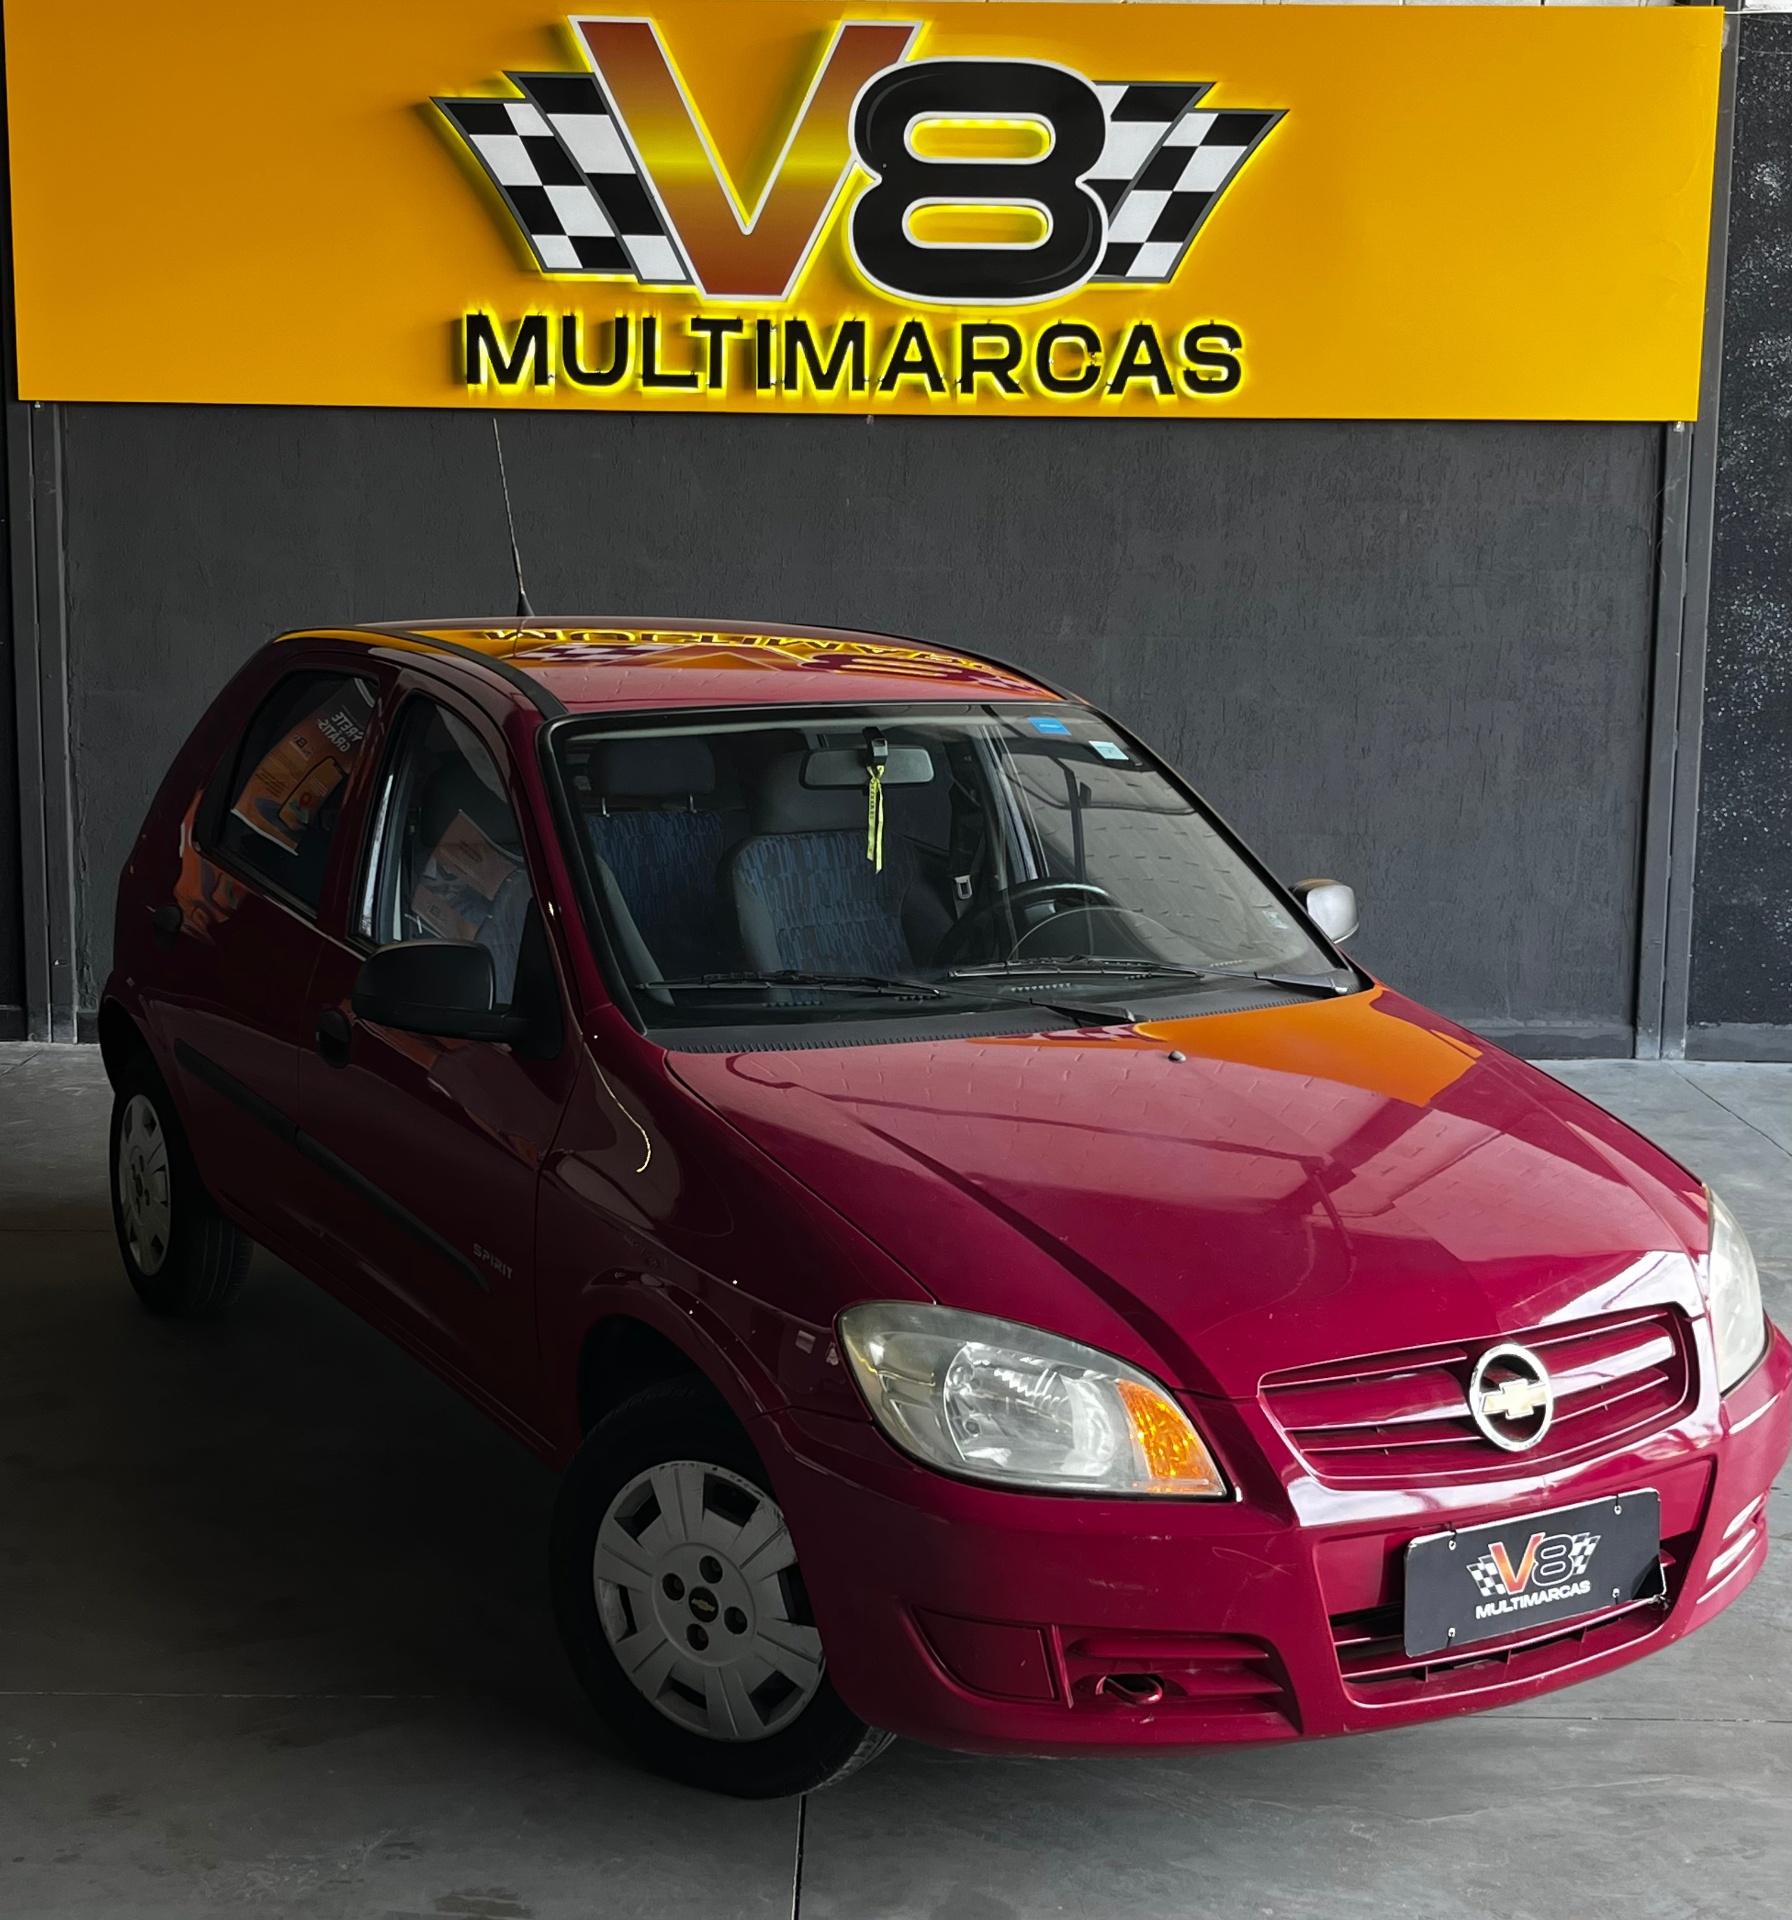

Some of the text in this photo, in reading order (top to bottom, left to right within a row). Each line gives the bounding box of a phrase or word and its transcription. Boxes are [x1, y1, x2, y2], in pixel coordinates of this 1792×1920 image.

[567, 14, 1108, 305] V8
[465, 313, 1243, 396] MULTIMARCAS
[473, 1243, 513, 1279] SPIRIT
[1488, 1532, 1575, 1595] V8
[1475, 1580, 1591, 1620] MULTIMARCAS
